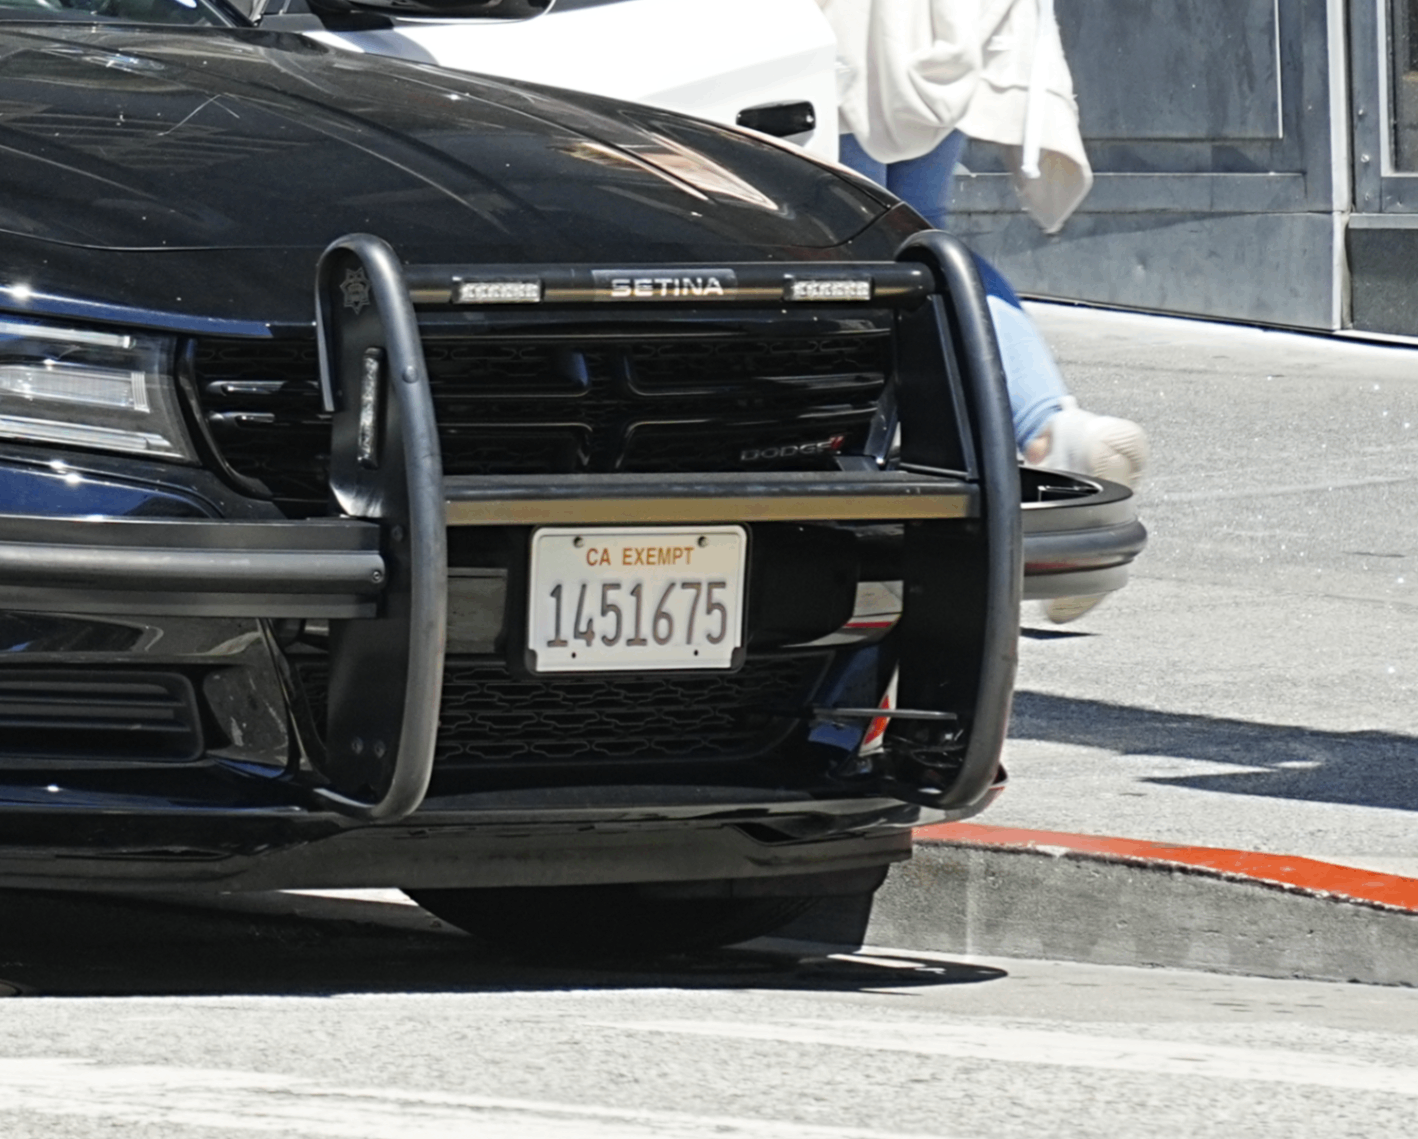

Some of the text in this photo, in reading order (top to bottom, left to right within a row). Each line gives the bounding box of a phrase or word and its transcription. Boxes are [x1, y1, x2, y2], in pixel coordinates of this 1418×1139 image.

[610, 276, 725, 298] SETINA
[741, 441, 832, 461] DODGE
[585, 546, 696, 567] CA EXEMPT
[546, 581, 728, 648] 1451675
